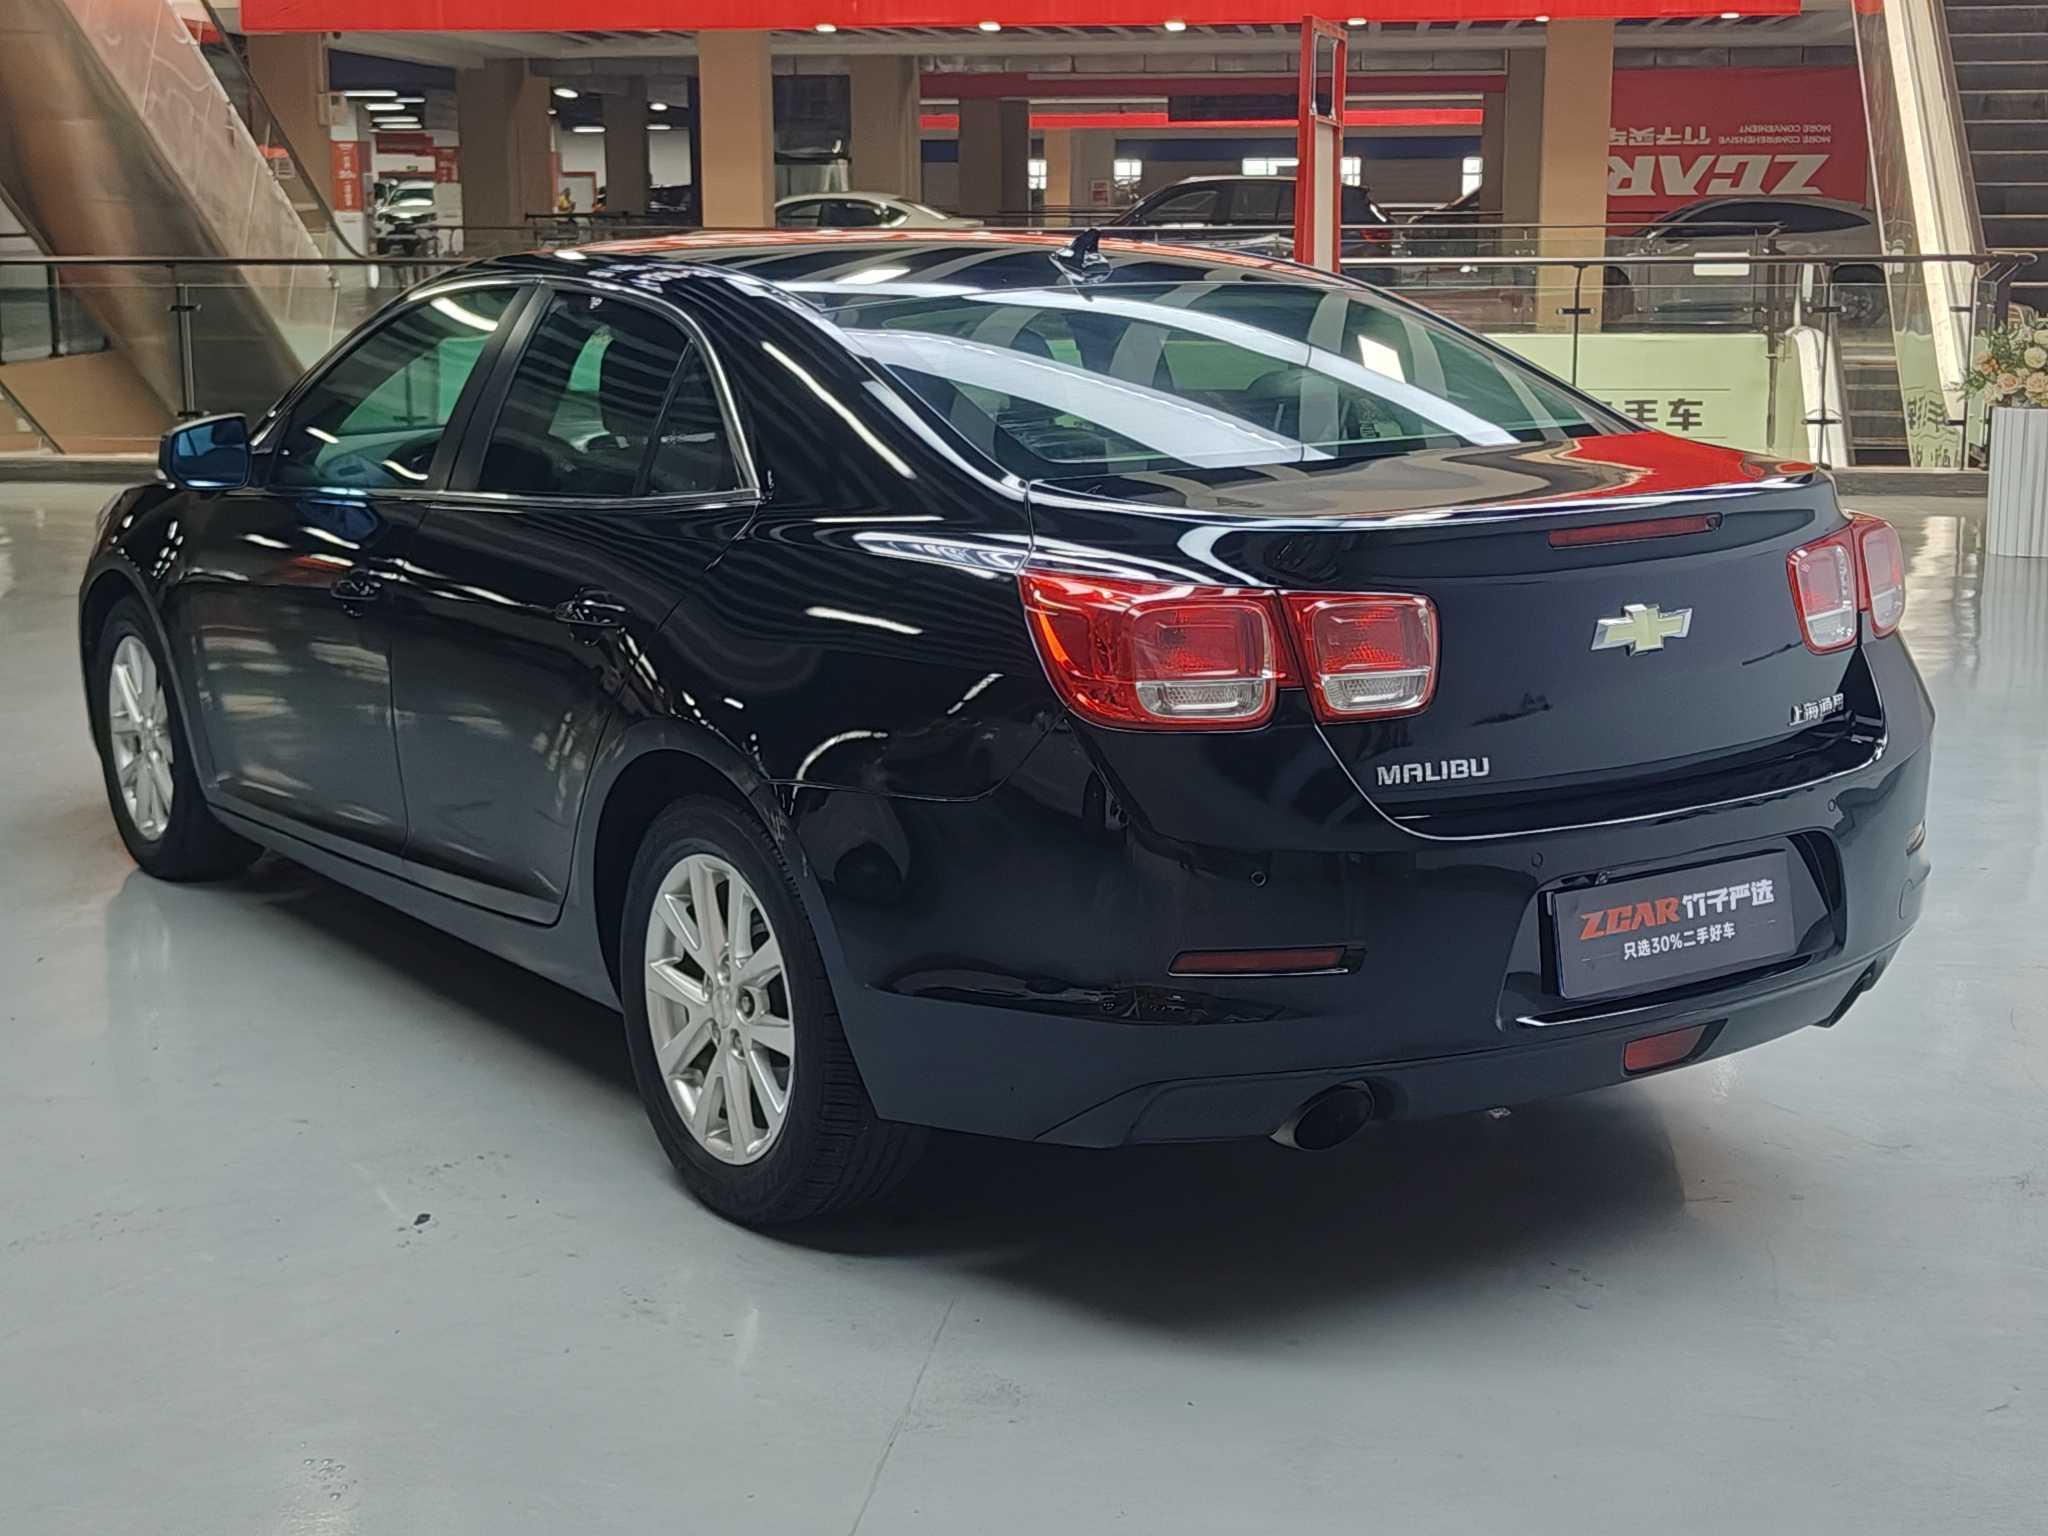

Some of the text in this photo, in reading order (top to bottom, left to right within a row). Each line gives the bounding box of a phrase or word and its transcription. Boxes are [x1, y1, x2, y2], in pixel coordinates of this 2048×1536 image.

[1608, 154, 1830, 196] ZCAR
[1789, 692, 1845, 727] 上海通用
[1376, 757, 1490, 786] MALIBU
[1580, 879, 1776, 941] ZCAR 竹子严选
[1623, 922, 1737, 961] 只选30%二手好车
